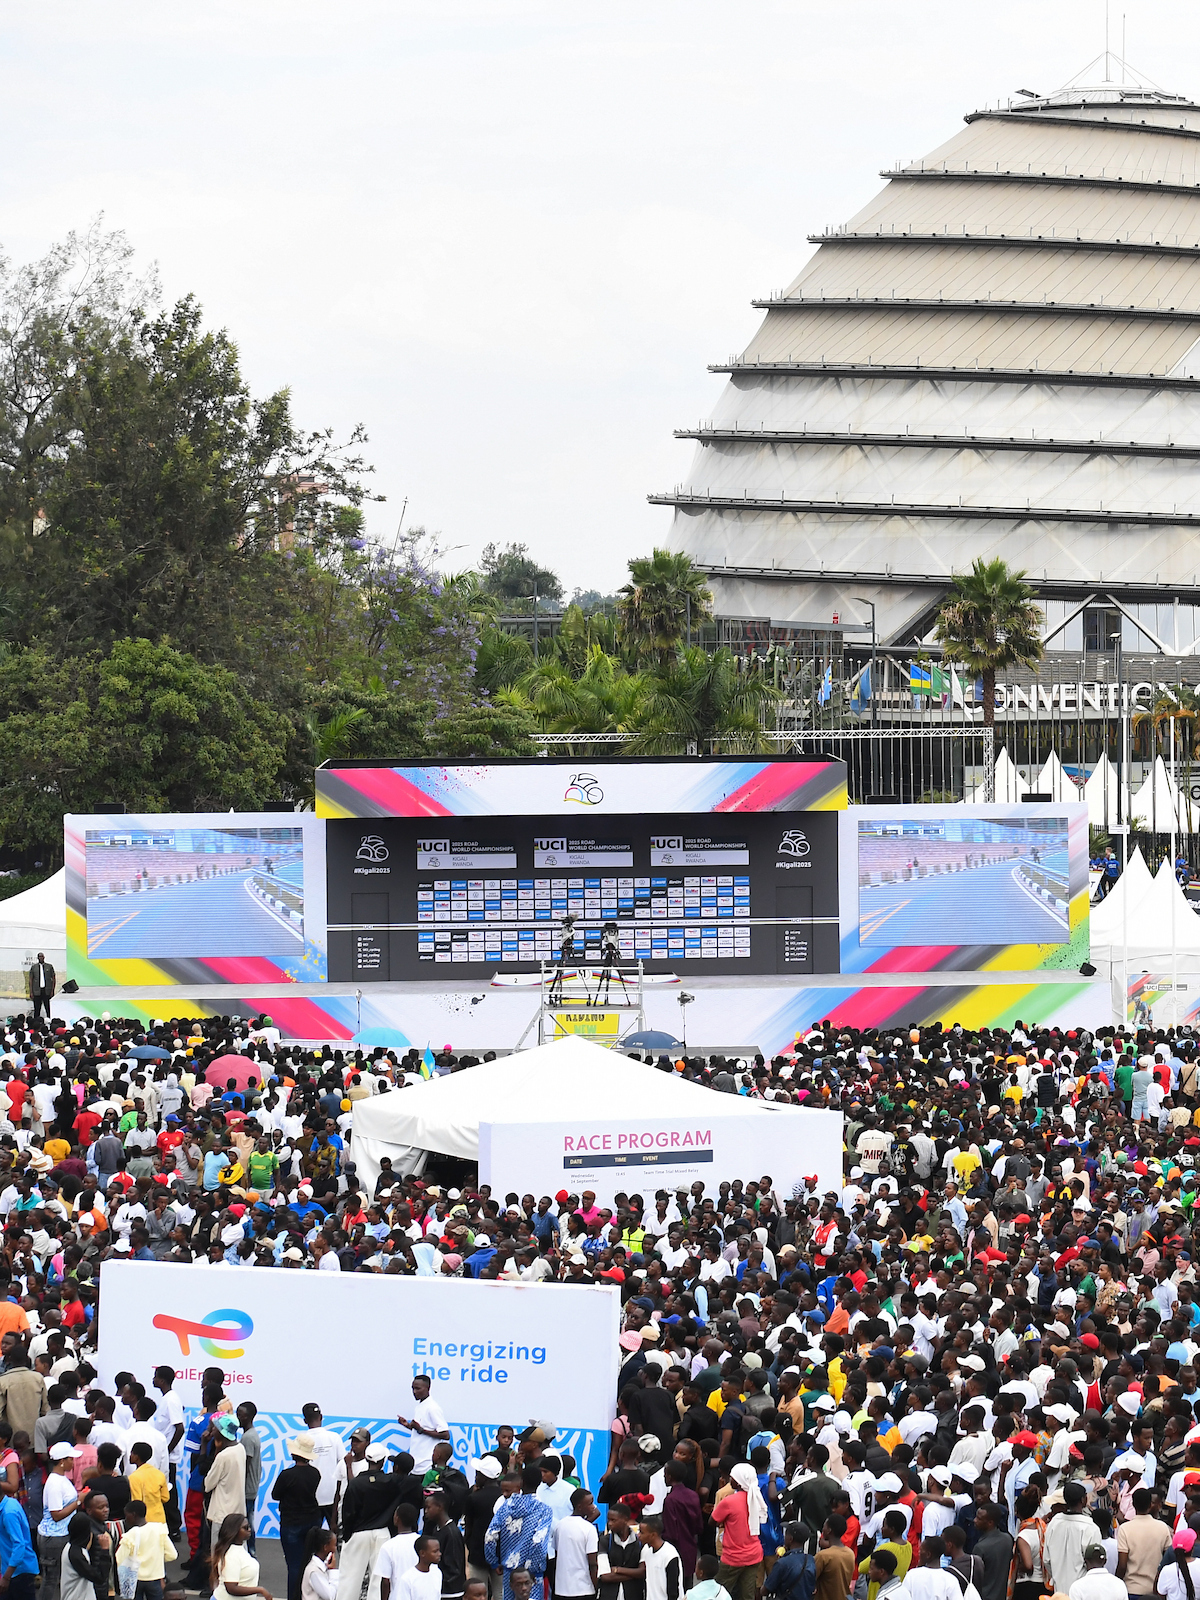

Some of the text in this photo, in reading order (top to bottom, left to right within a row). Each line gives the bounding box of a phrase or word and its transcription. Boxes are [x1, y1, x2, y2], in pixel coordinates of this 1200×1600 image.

[422, 842, 447, 852] UCI
[539, 841, 564, 850] UCI
[656, 839, 680, 849] UCI
[564, 1130, 712, 1151] RACE PROGRAM
[413, 1338, 546, 1364] Energizing
[412, 1362, 508, 1383] the ride
